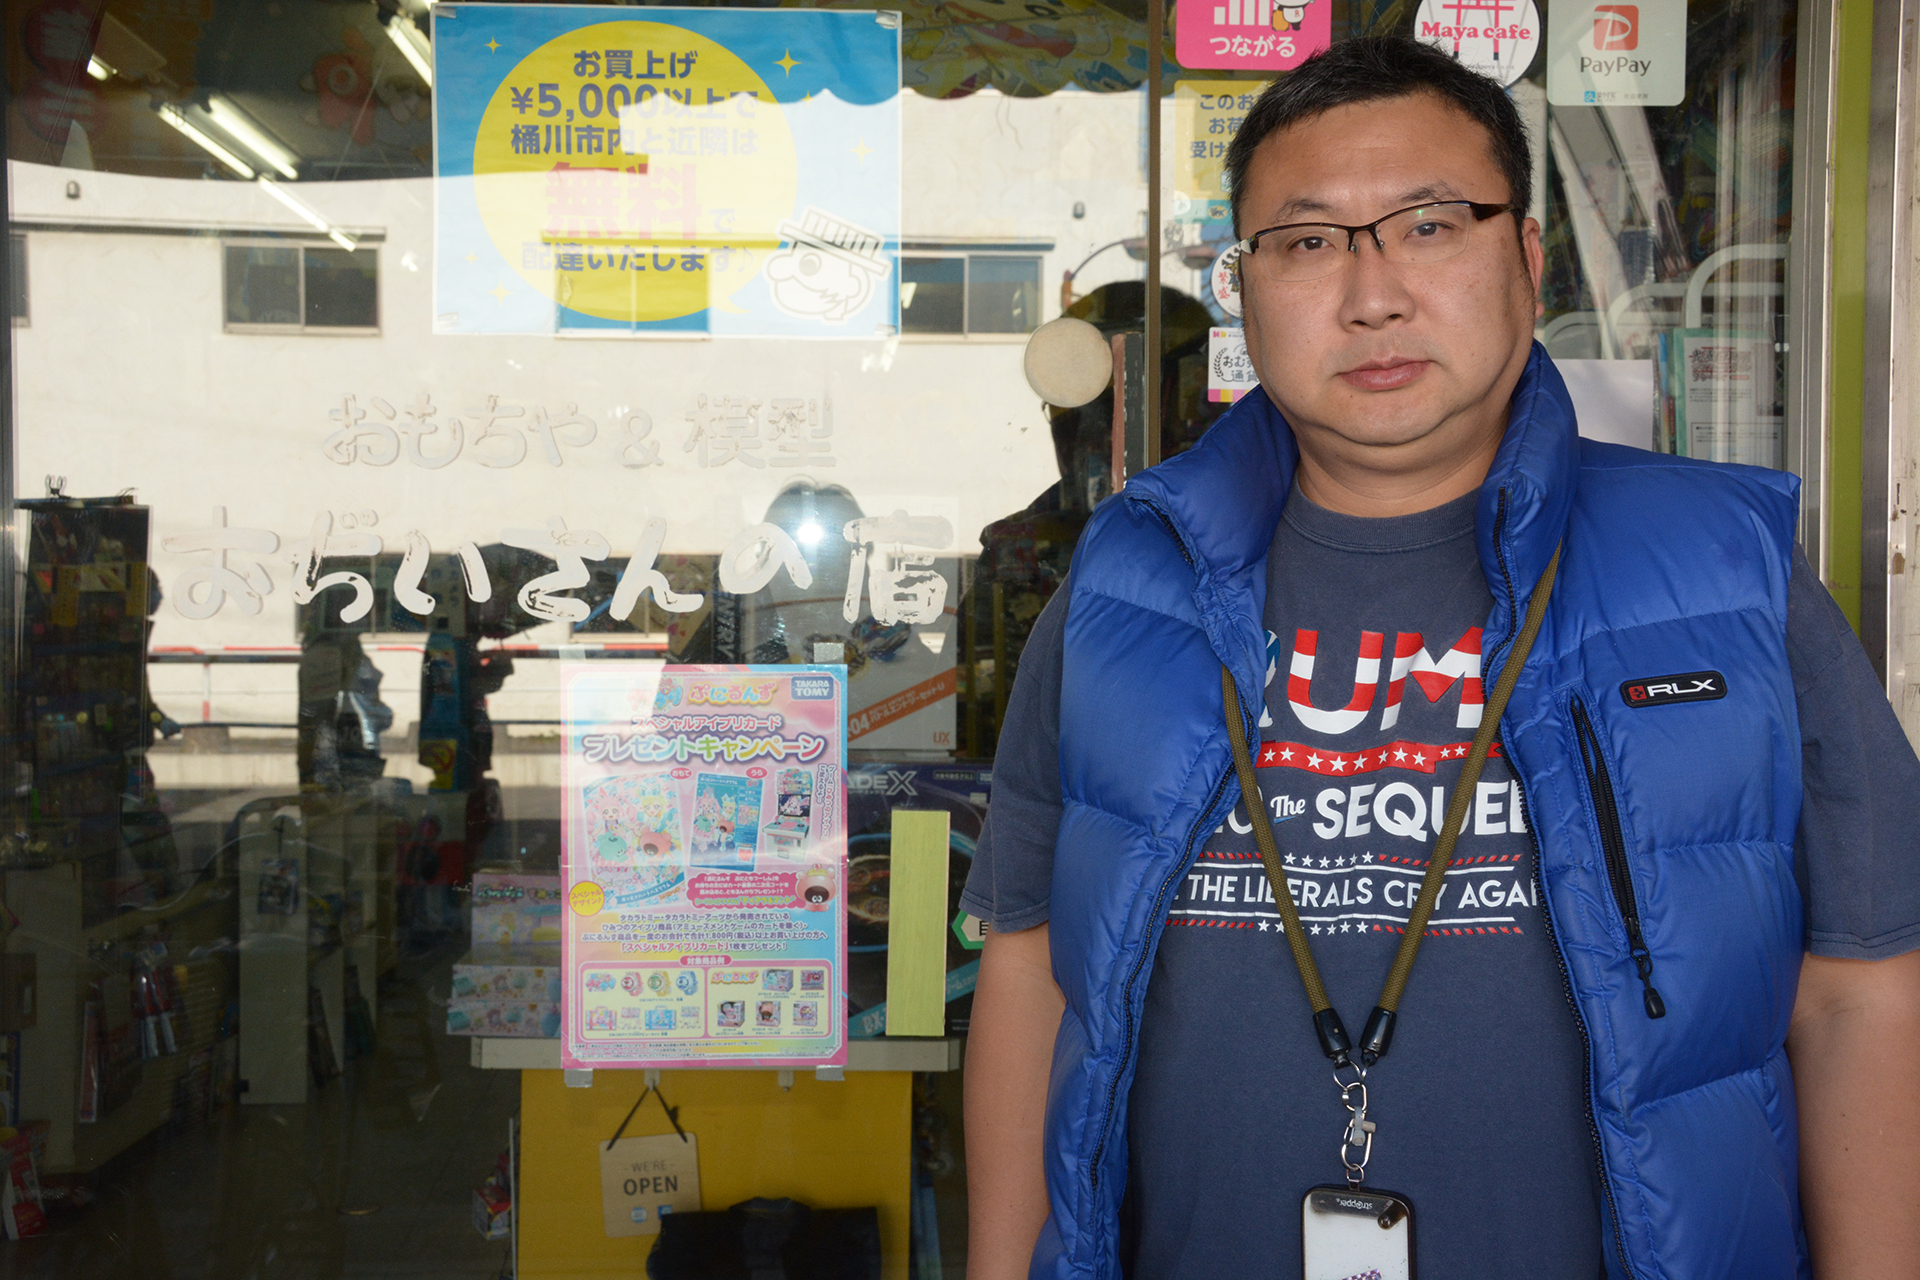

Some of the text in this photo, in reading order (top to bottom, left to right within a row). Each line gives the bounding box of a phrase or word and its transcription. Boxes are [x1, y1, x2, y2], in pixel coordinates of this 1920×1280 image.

[1421, 21, 1531, 40] Maya cafe
[1209, 34, 1296, 57] つながる
[574, 50, 698, 80] お買上げ
[1580, 56, 1651, 76] PayPay
[510, 83, 758, 122] ¥5,000以上で
[1199, 94, 1260, 111] このお
[511, 124, 759, 156] 桶川市内と近隣は
[1190, 141, 1232, 159] 受け
[1258, 626, 1484, 735] UM
[1646, 678, 1717, 697] RLX
[690, 682, 778, 703] ぷにるんず
[795, 688, 830, 696] TOMY
[631, 716, 781, 731] スペシャルアイプリカード
[933, 732, 950, 744] UX
[587, 736, 821, 760] プレゼントキャンペーン
[672, 769, 691, 778] おもて
[751, 769, 763, 777] うら
[1271, 795, 1306, 817] The
[571, 889, 602, 900] スペシャル
[1188, 875, 1238, 903] THE
[687, 957, 725, 966] 対象商品例
[623, 1175, 678, 1196] OPEN
